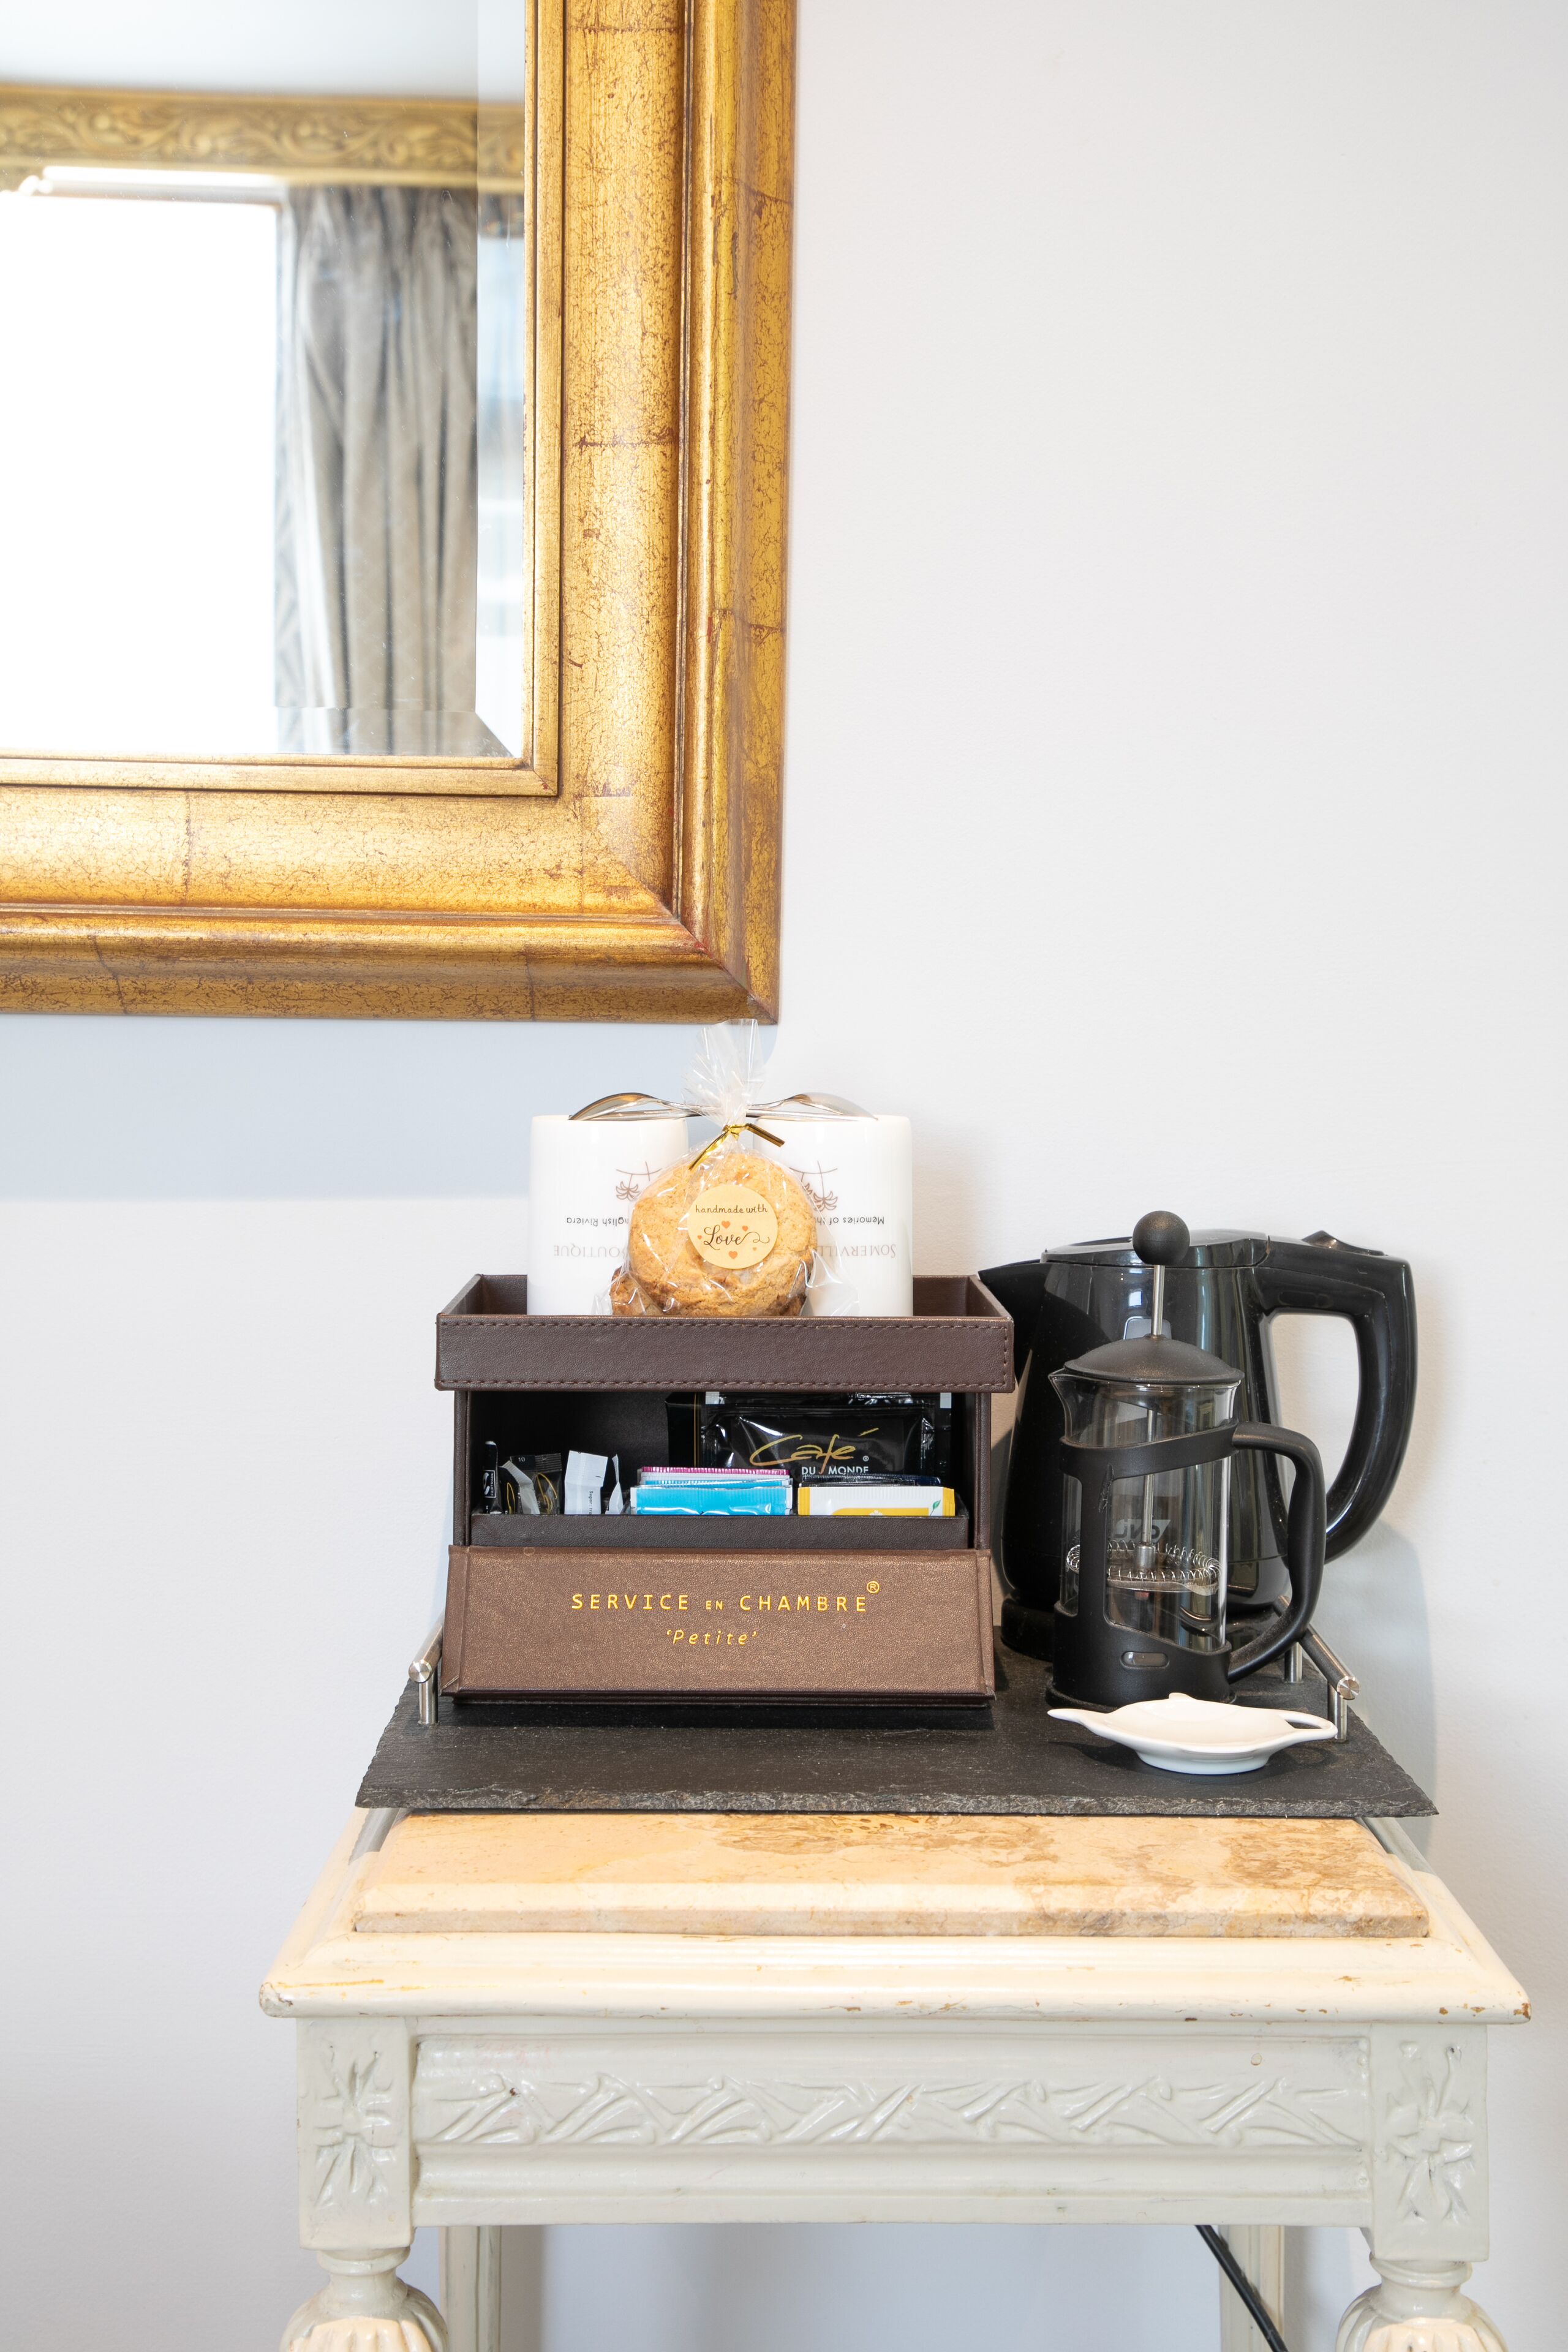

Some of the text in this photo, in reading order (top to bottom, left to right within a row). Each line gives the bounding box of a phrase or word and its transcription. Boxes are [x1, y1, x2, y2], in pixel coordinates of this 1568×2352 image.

[695, 1204, 767, 1213] handmade with
[567, 1217, 628, 1226] nglish Riviera
[829, 1216, 839, 1225] of
[843, 1216, 884, 1224] Memories
[704, 1224, 769, 1250] Love
[816, 1244, 896, 1258] SOMERVILL
[750, 1428, 878, 1474] Café
[802, 1466, 815, 1475] DU
[571, 1594, 688, 1610] SERVICE
[706, 1600, 723, 1610] EN
